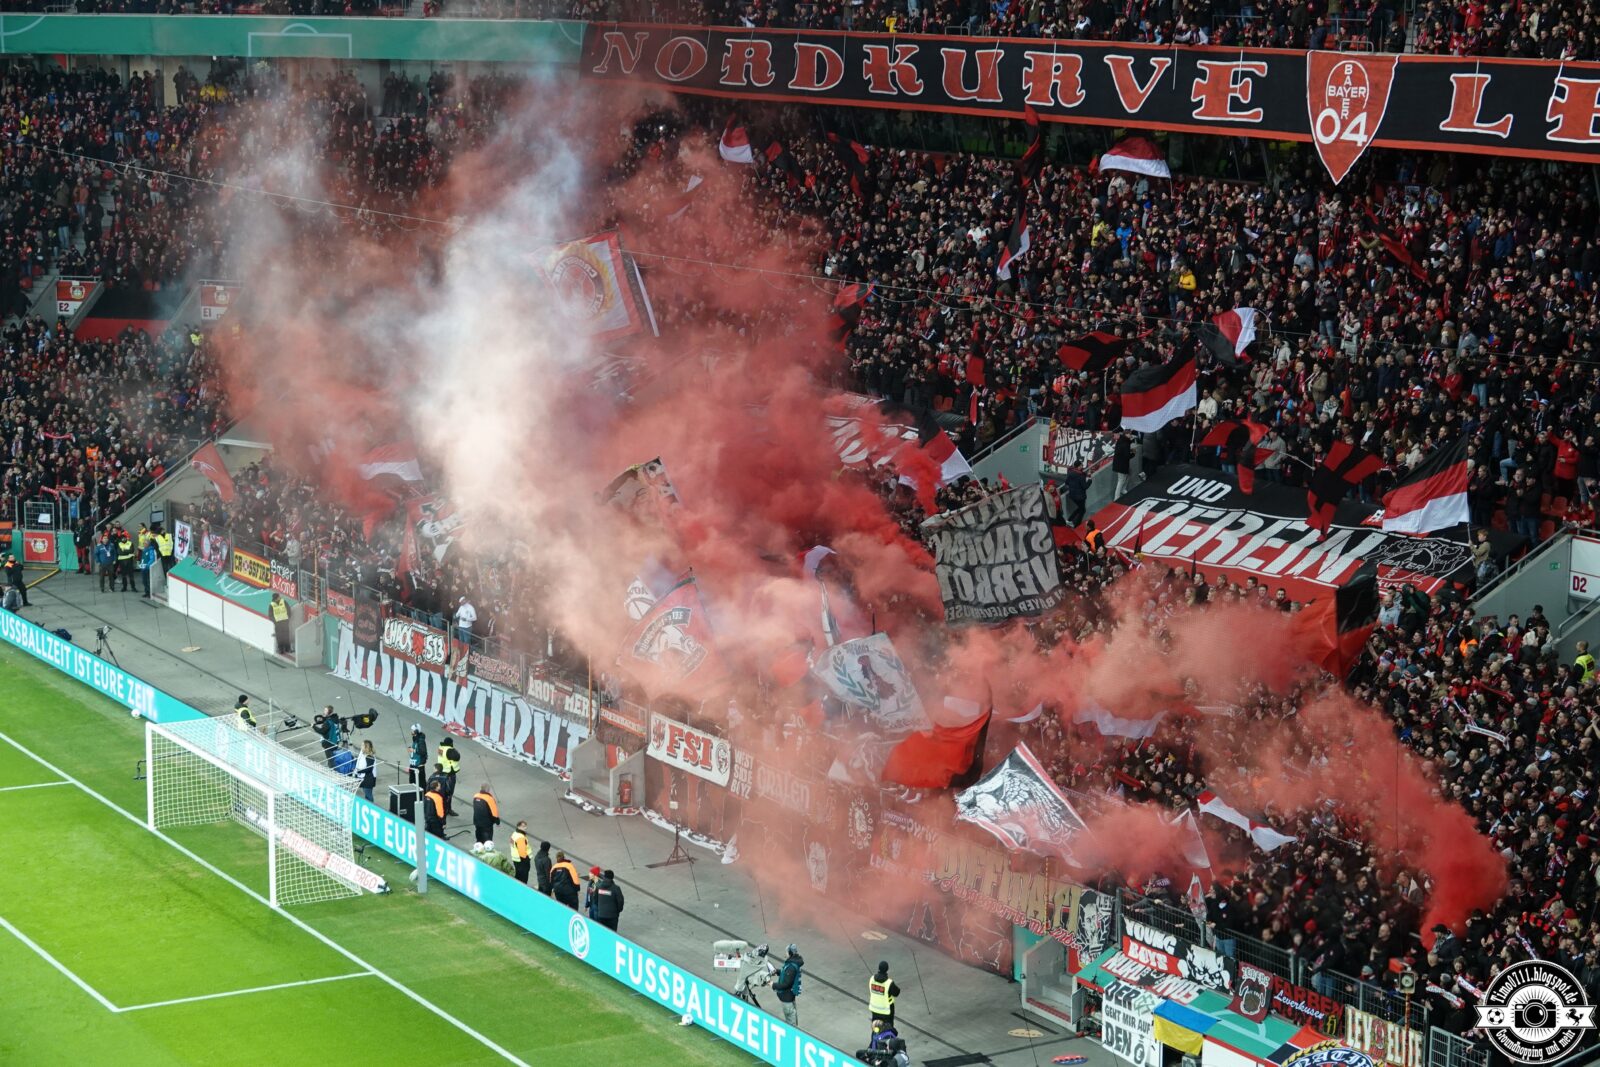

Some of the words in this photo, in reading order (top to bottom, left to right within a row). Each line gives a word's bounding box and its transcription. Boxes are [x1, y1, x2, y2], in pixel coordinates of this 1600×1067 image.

[593, 31, 1268, 122] NORDKURVE
[1328, 85, 1366, 98] BAYER
[1316, 107, 1368, 147] 04
[59, 302, 70, 312] E2
[203, 307, 212, 317] E1
[1166, 475, 1232, 502] UND
[1107, 499, 1388, 583] VEREIN
[1572, 575, 1587, 593] D2
[0, 612, 71, 670] USSBALLZEIT
[74, 651, 92, 681] IST
[93, 660, 125, 698] EURE
[384, 618, 413, 654] CHAOS
[423, 633, 445, 663] 513
[667, 723, 713, 772] FSI
[354, 802, 382, 840] IST
[385, 816, 428, 867] EUR
[435, 843, 480, 897] ZEIT.
[355, 871, 378, 890] ERGO
[1123, 917, 1177, 955] YOUNG
[1128, 940, 1169, 972] BOYS
[615, 940, 786, 1062] FUSSBALLZEIT
[1104, 981, 1141, 1011] DER
[1273, 989, 1326, 1020] Leverkusen
[1105, 1004, 1121, 1021] GEHT
[1122, 1012, 1136, 1029] MIR
[1137, 1019, 1151, 1036] AUF
[1104, 1021, 1132, 1057] DEN
